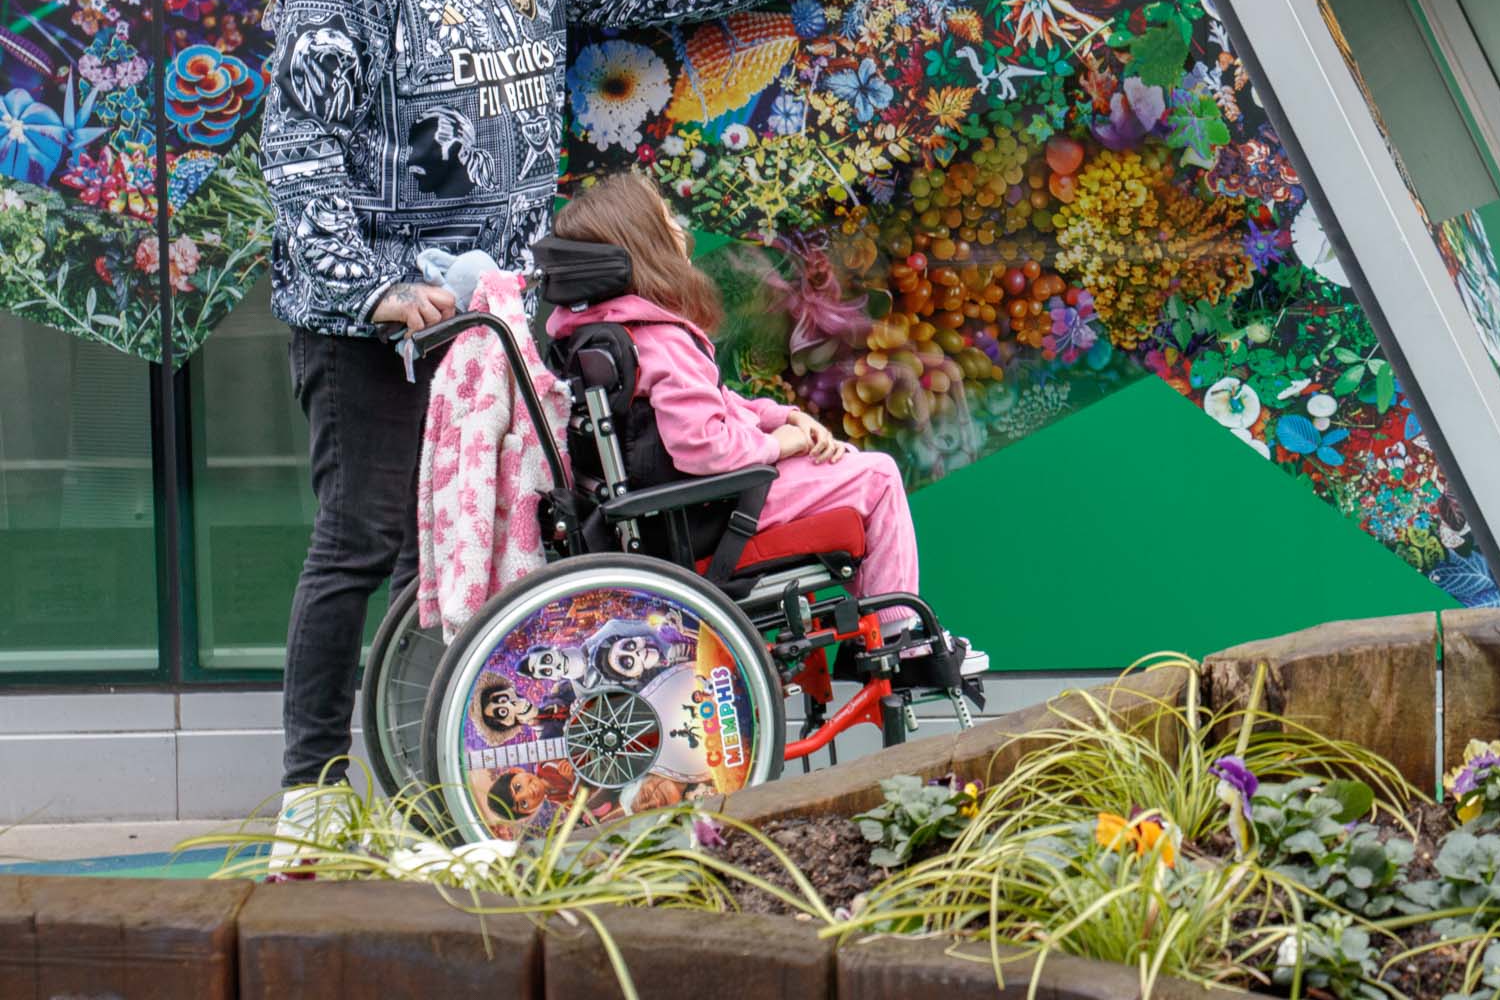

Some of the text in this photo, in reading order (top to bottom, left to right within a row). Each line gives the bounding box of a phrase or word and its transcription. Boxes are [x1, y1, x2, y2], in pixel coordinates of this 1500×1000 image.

[449, 40, 554, 86] Emirates
[504, 75, 549, 112] BETTER
[700, 701, 723, 767] COCO
[711, 666, 743, 767] MEMPHIS
